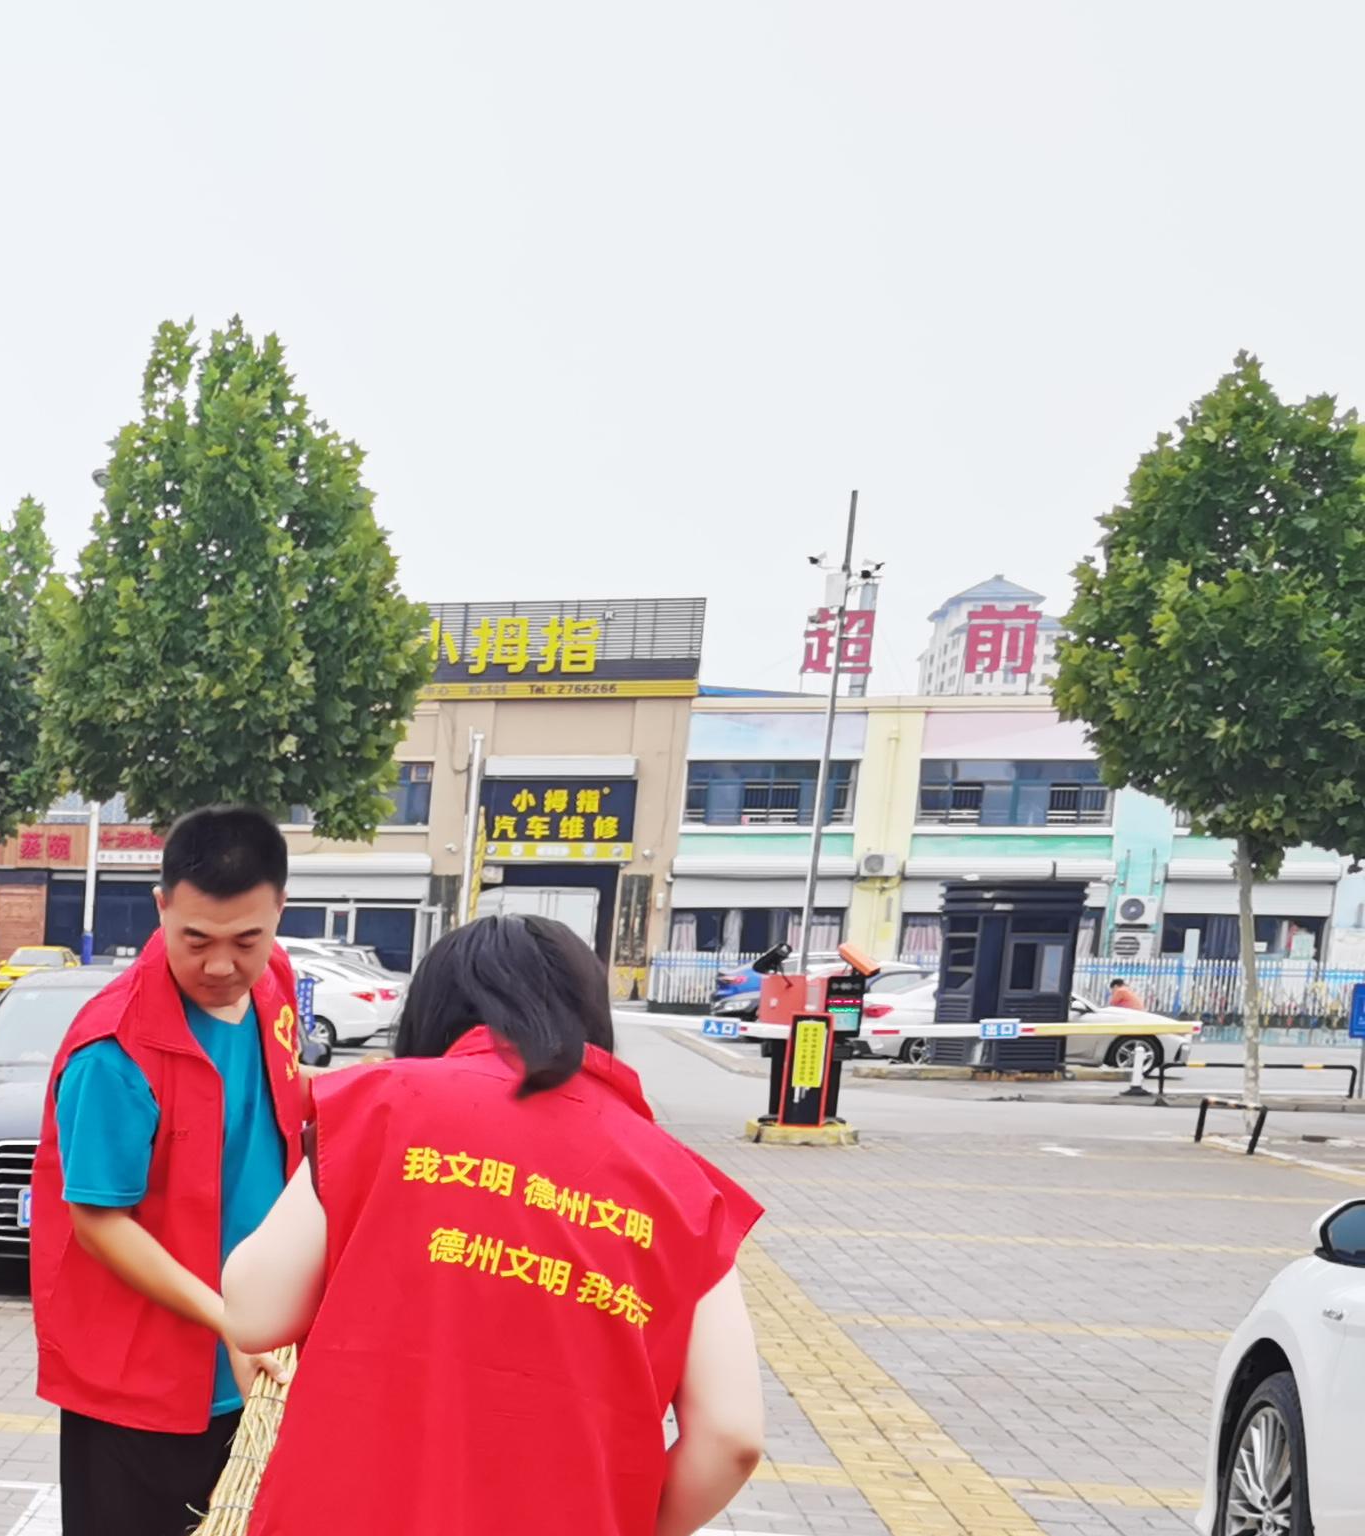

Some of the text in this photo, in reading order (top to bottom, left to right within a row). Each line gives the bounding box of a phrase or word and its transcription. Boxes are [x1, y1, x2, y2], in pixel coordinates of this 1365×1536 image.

[492, 815, 619, 839] 汽车维修
[706, 1021, 734, 1035] 入口
[985, 1023, 1015, 1036] 出口
[403, 1146, 655, 1249] 我文明 德州文明
[427, 1227, 573, 1296] 德州文明
